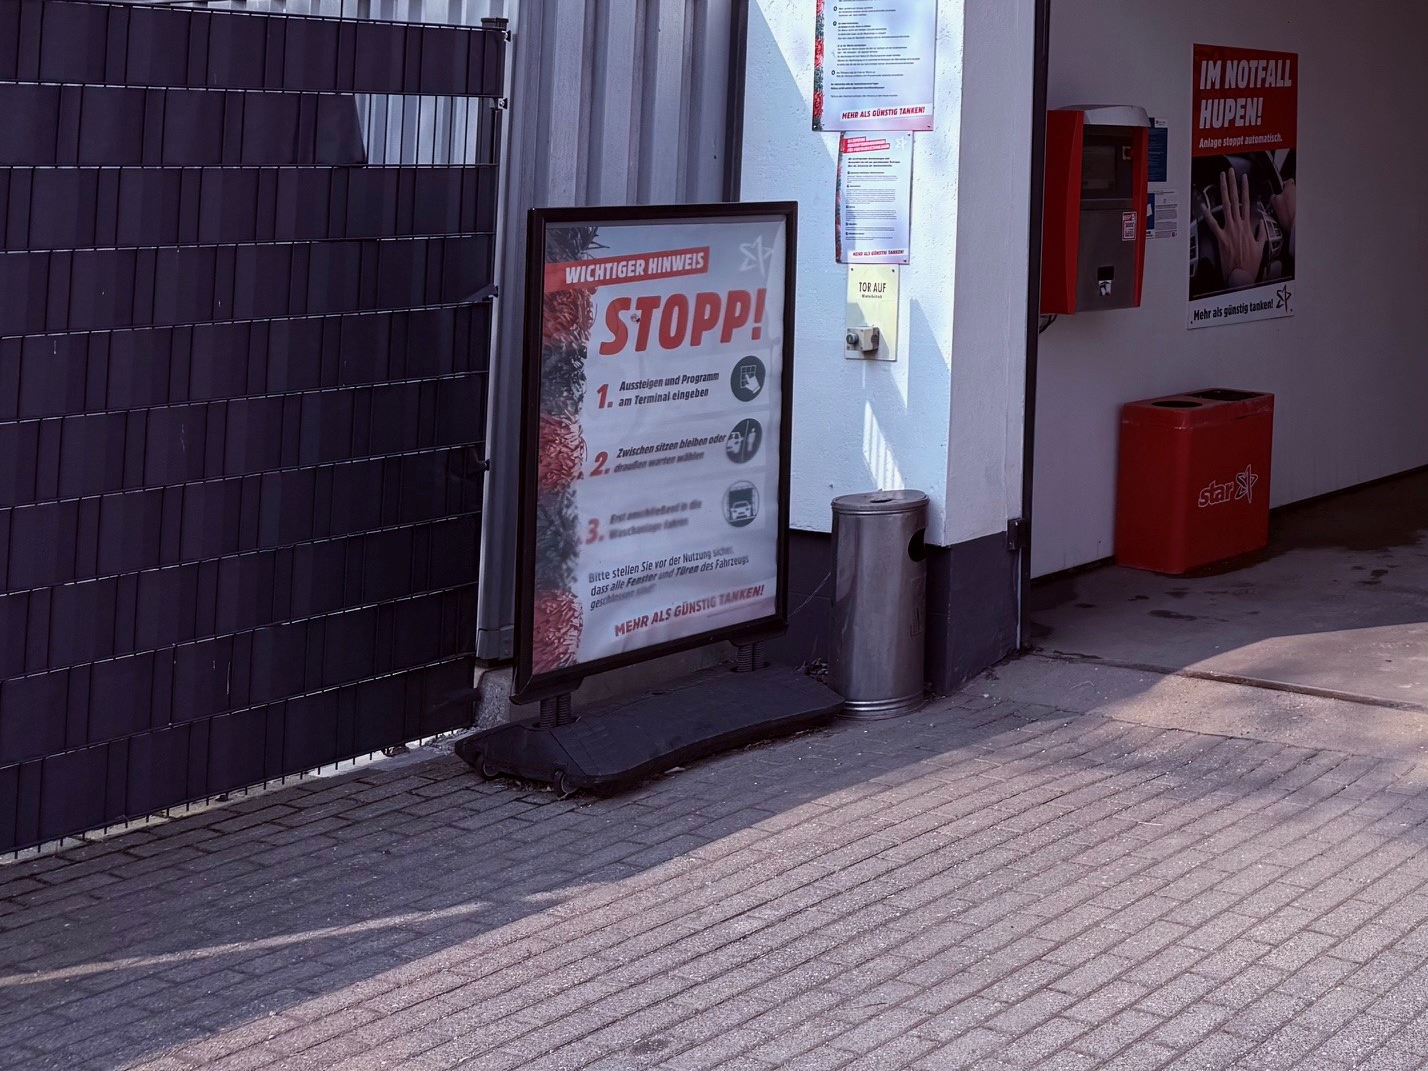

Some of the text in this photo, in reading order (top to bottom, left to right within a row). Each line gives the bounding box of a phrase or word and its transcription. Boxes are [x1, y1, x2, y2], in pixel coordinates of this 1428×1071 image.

[1199, 59, 1292, 89] IM NOTFALL
[841, 106, 926, 120] MEHR ALS GÜNSTIG TANKEN!
[1199, 97, 1264, 129] HUPEN!
[1199, 133, 1283, 149] Anlage stoppt automatisch.
[565, 252, 705, 284] WICHTIGER HINWEIS
[859, 282, 887, 293] TOR AUF
[599, 288, 767, 356] STOPP!
[1193, 298, 1274, 321] Mehr als günstig tanken!
[619, 372, 720, 392] Aussteigen und Programm
[596, 383, 613, 409] 1.
[618, 388, 709, 407] am Terminal eingeben
[616, 433, 727, 458] Zwischen sitzen bleiben oder
[590, 451, 611, 477] 2.
[613, 460, 648, 473] draußen
[648, 456, 676, 467] warten
[1197, 479, 1235, 508] star
[586, 518, 605, 544] 3.
[588, 571, 610, 583] Bitte
[612, 564, 639, 579] stellen
[640, 561, 653, 573] Sie
[654, 558, 667, 569] vor
[668, 555, 681, 566] der
[682, 550, 712, 564] Nutzung
[590, 555, 750, 597] dass alle Fenster und Türen des Fahrzeugs
[614, 614, 649, 637] MEHR
[650, 607, 672, 625] ALS
[673, 595, 716, 617] GÜNSTIG
[718, 584, 765, 605] TANKEN!
